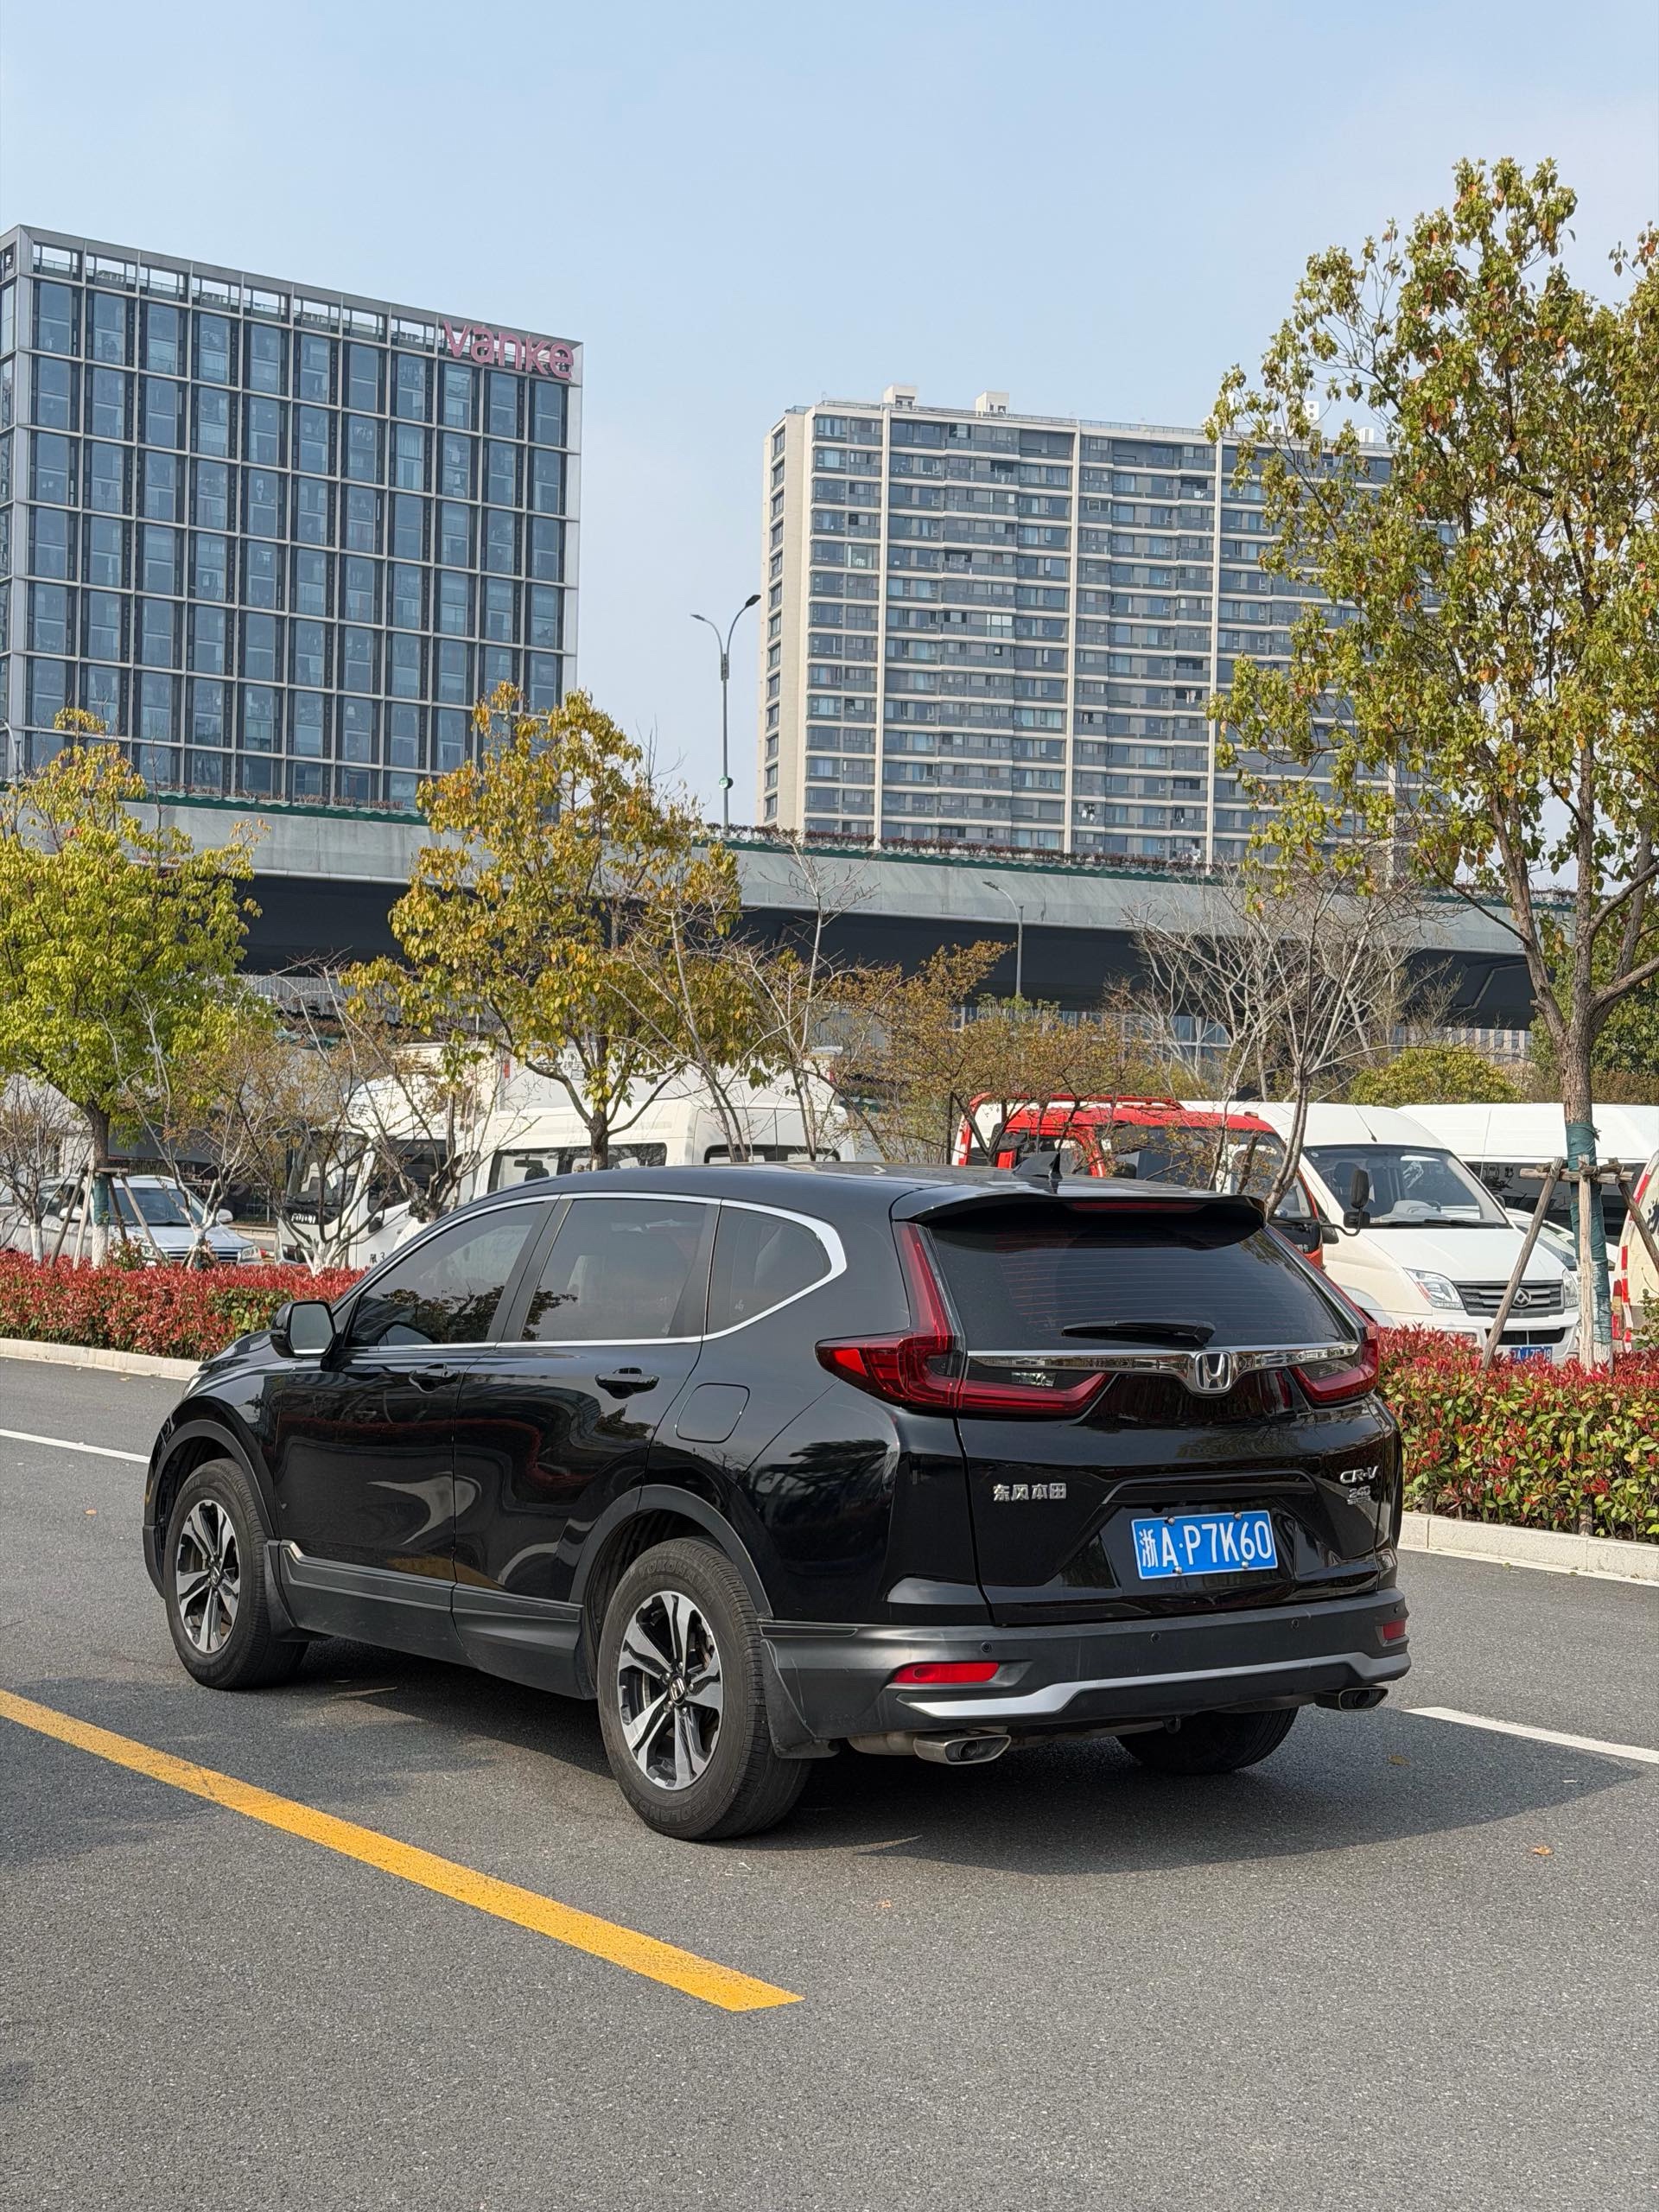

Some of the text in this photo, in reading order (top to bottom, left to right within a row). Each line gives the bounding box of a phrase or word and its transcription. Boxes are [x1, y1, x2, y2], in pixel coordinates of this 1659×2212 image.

[442, 319, 574, 380] vanke
[1340, 1465, 1379, 1484] CR-V
[993, 1483, 1067, 1502] 东风本田
